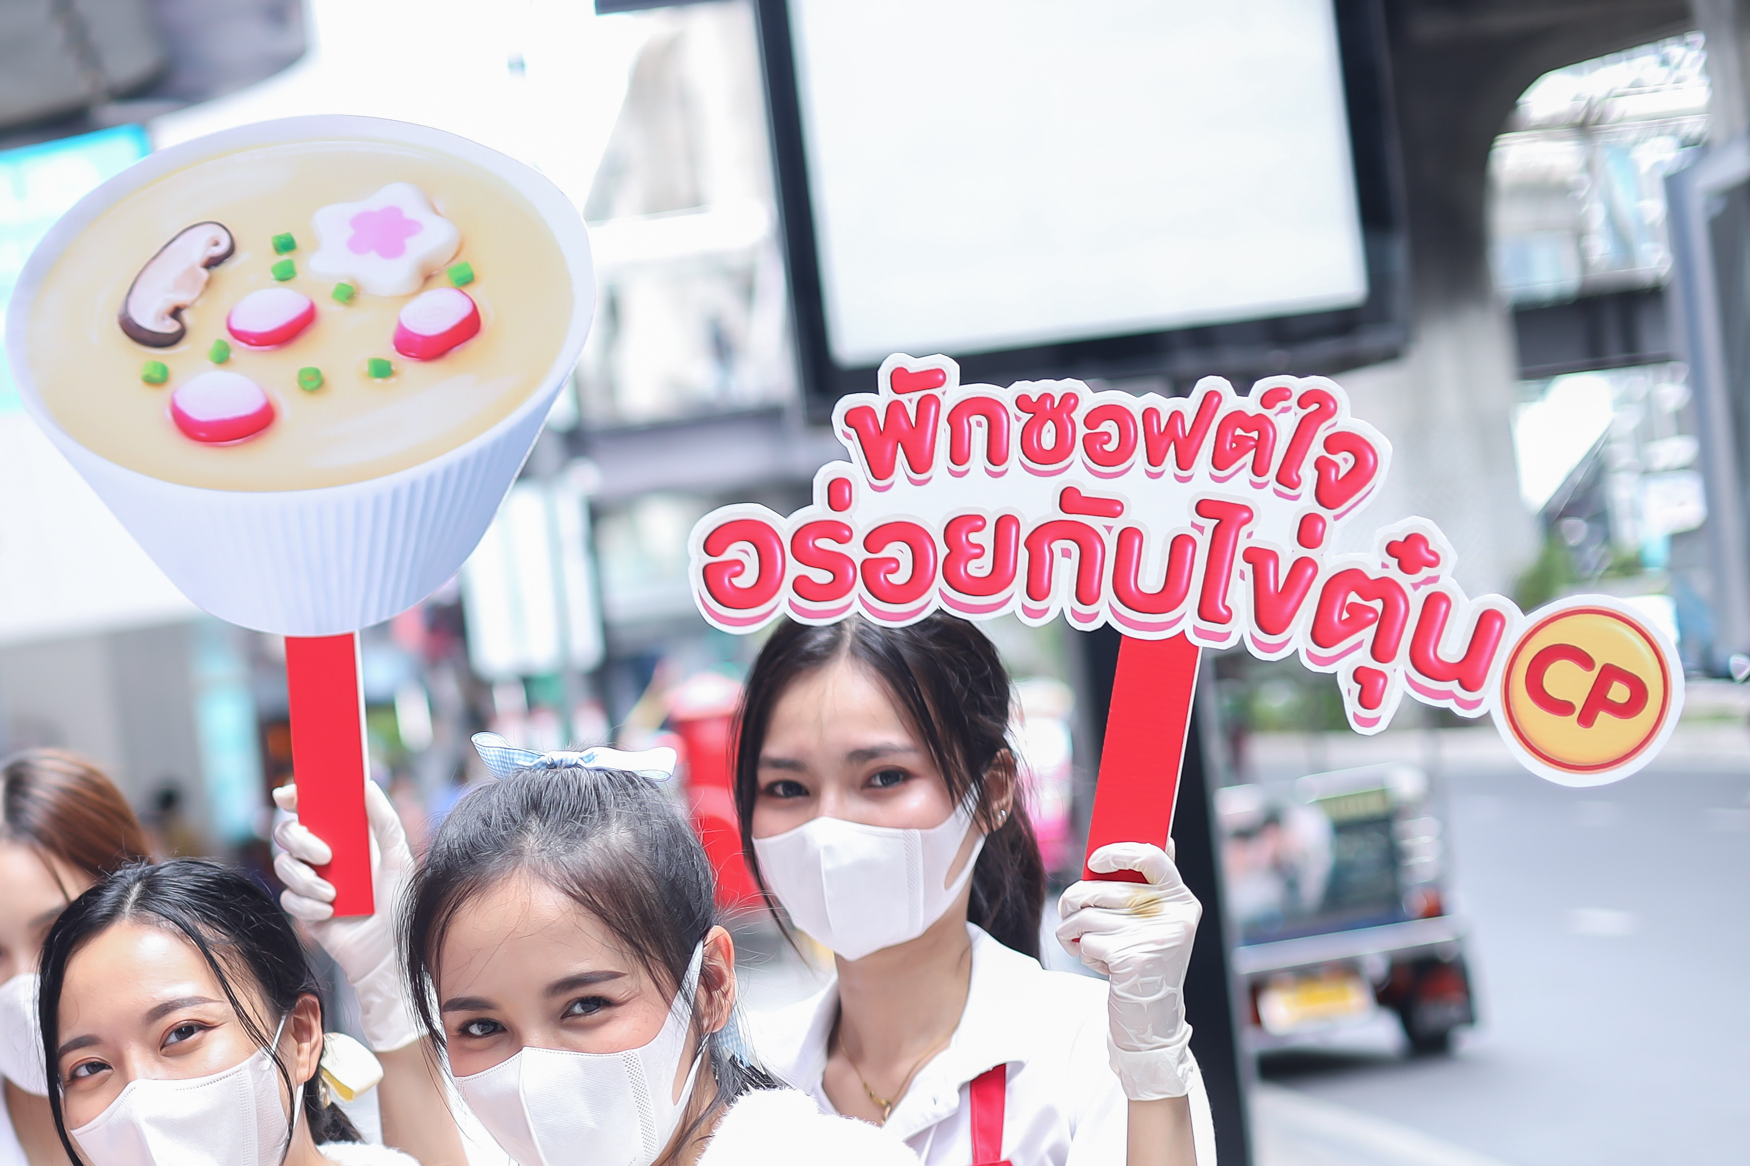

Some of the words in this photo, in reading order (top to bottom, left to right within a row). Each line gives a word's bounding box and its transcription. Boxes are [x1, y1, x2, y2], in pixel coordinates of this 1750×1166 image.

[844, 366, 1379, 510] พักซอฟต์ใจ
[703, 476, 1505, 711] อร่อยกับไข่ตุ๋น
[1525, 643, 1649, 730] CP
